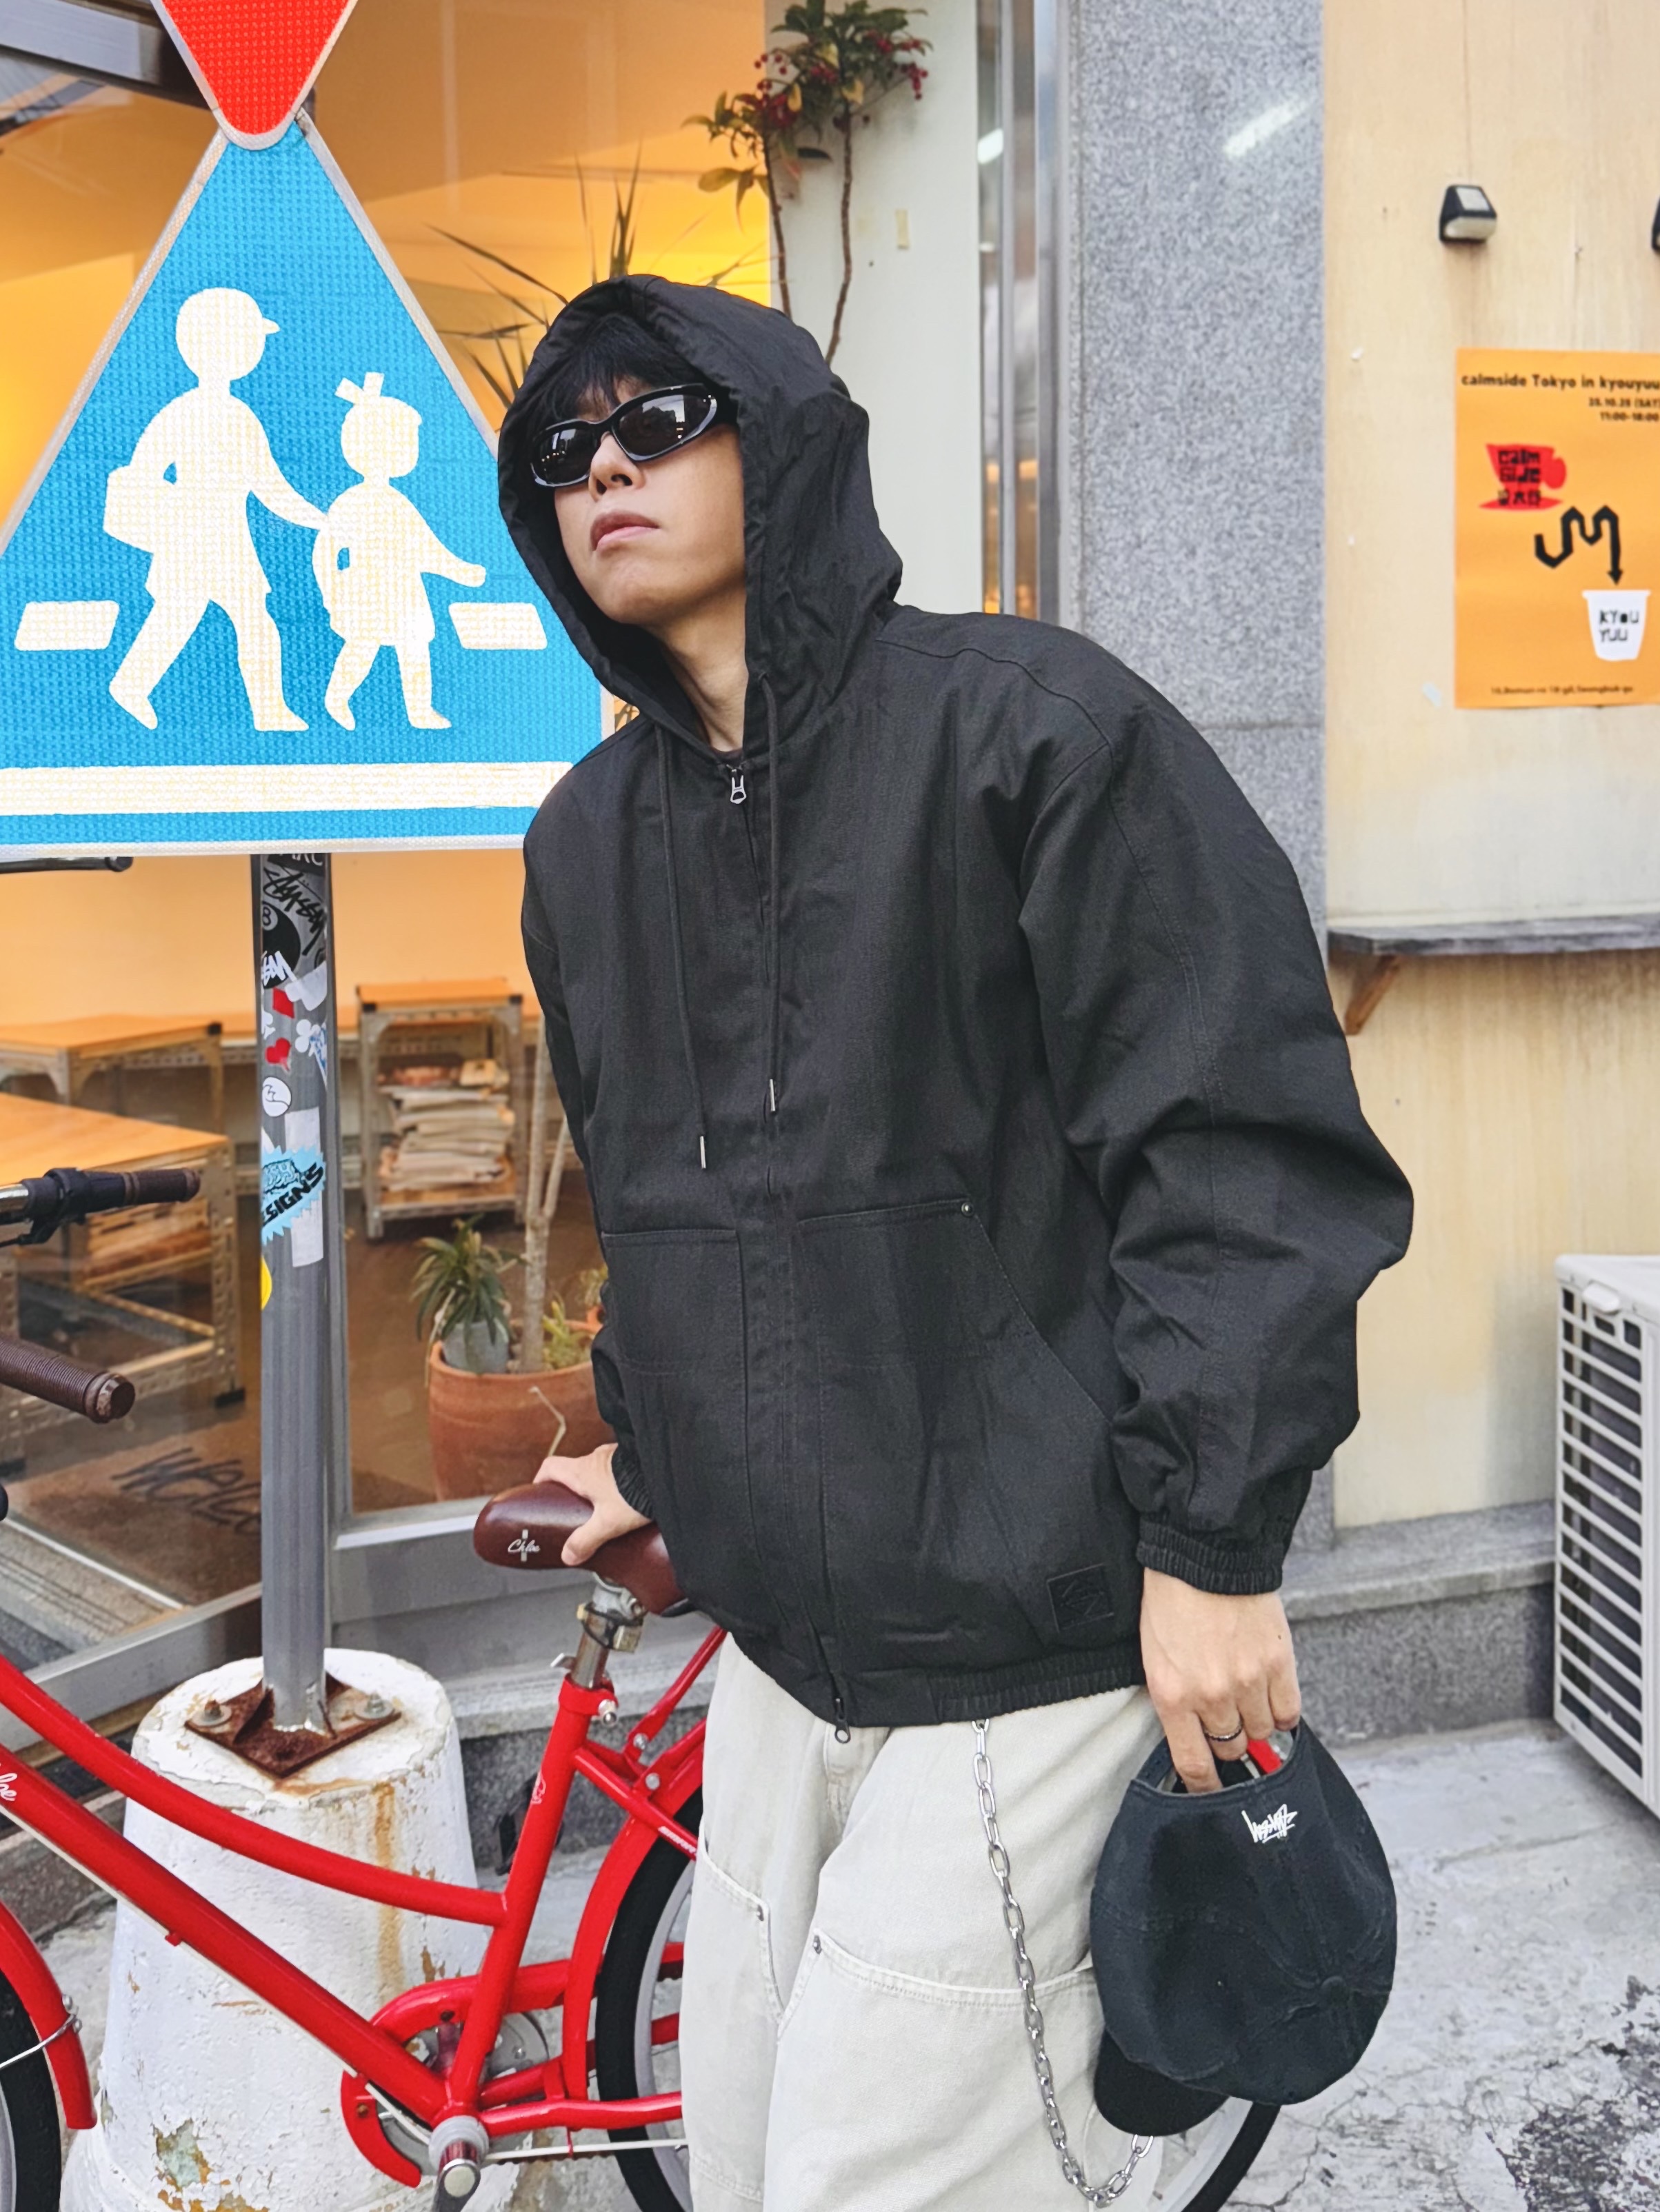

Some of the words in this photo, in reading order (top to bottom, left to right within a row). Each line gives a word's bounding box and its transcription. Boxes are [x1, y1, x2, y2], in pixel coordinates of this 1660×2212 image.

[1461, 372, 1527, 387] calmside
[1532, 374, 1577, 392] Tokyo
[1581, 374, 1594, 388] in
